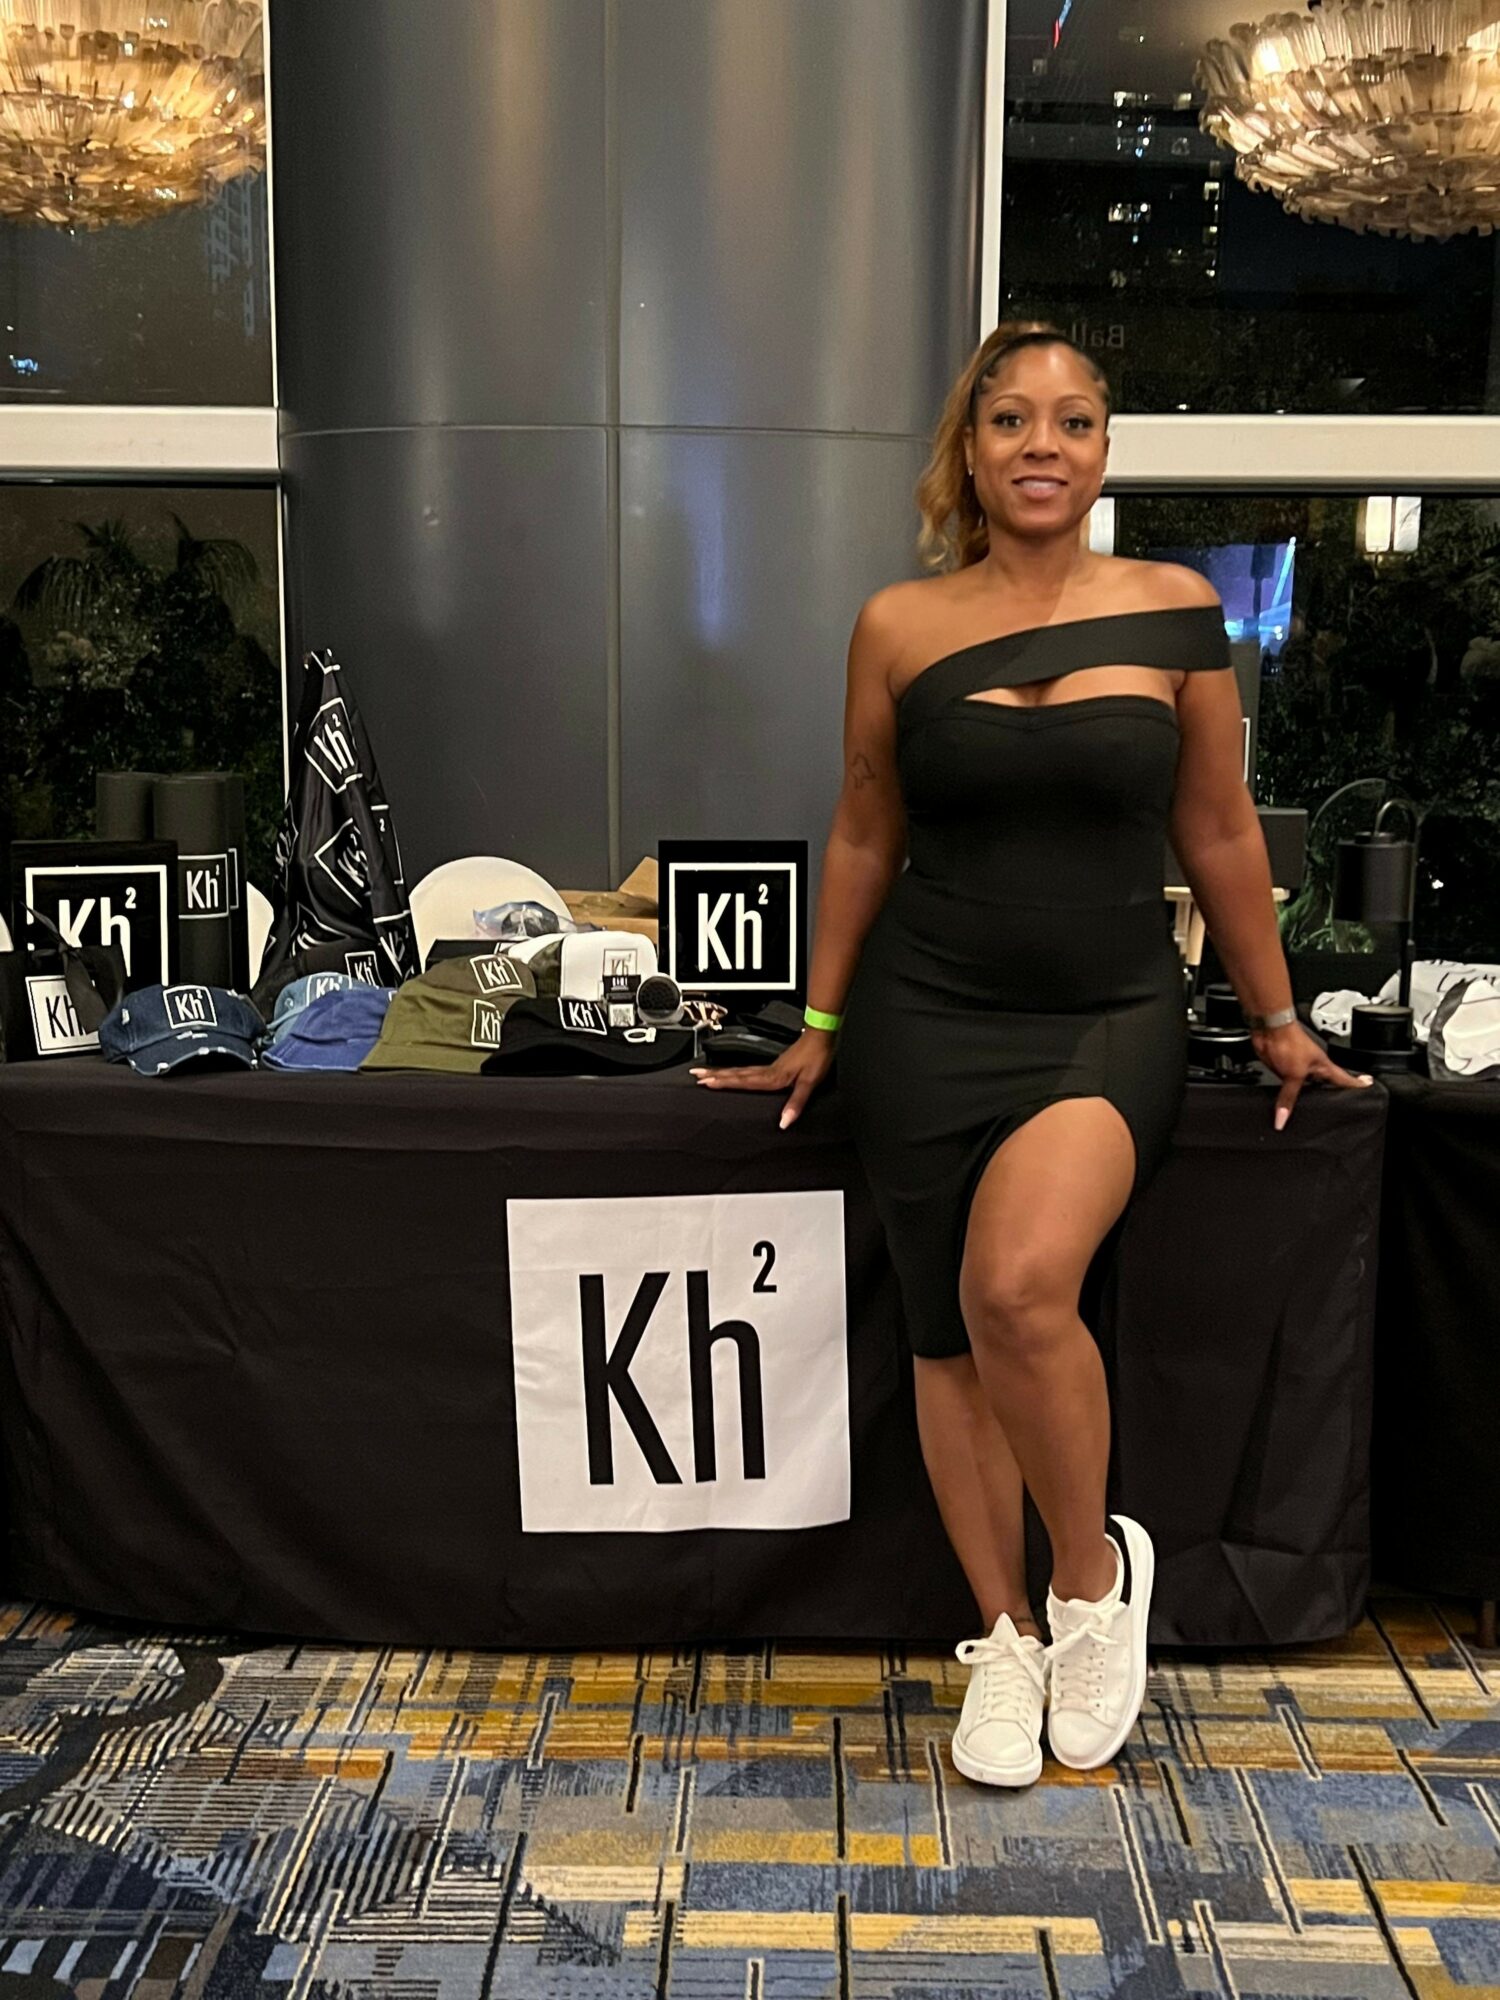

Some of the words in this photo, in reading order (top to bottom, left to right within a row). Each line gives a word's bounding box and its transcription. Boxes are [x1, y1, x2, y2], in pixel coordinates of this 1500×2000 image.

[698, 883, 769, 972] Kh²
[45, 994, 84, 1039] Kh
[579, 1240, 777, 1485] Kh²
